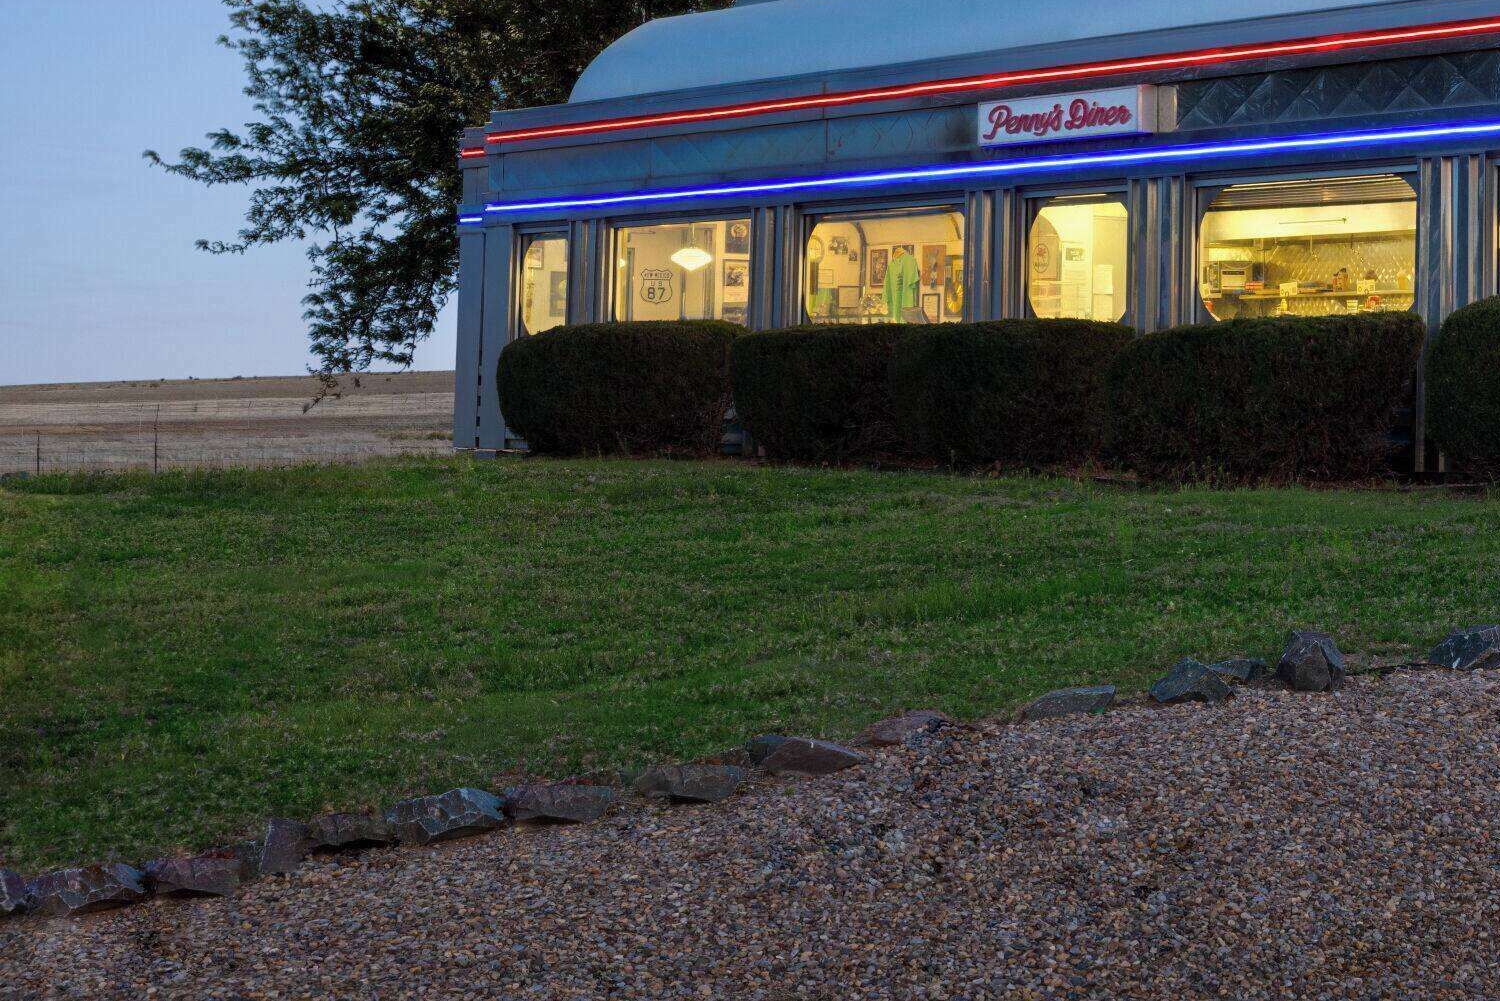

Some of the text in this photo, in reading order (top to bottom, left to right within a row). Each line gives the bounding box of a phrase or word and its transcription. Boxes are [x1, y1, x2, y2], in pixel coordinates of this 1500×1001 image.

[983, 98, 1132, 140] Penny's Diner
[647, 287, 666, 300] 87
